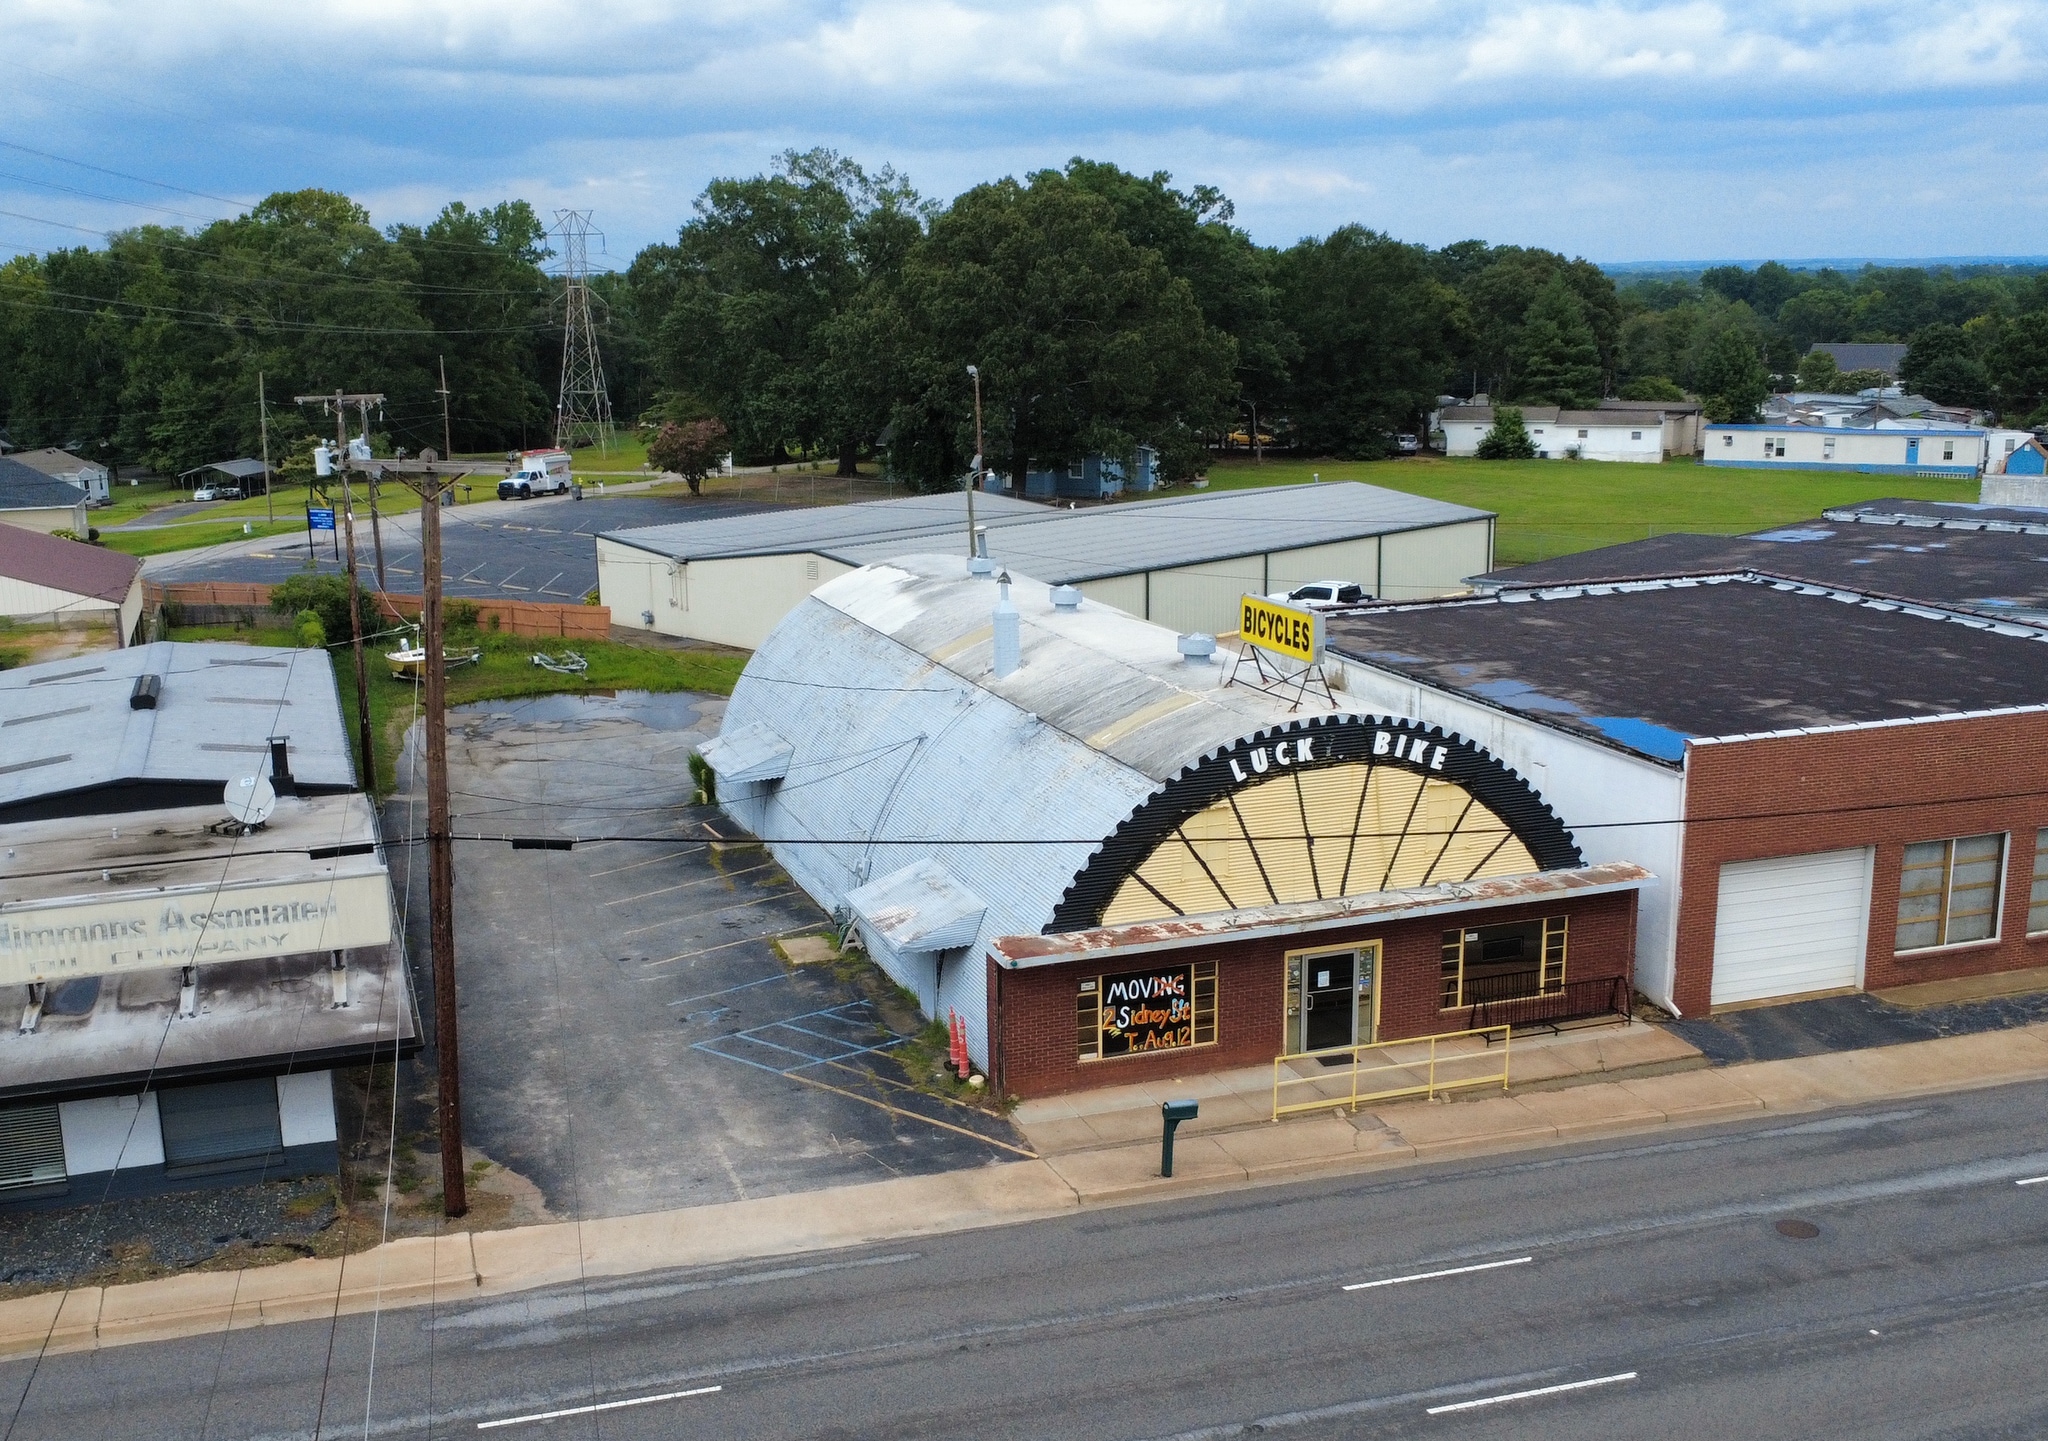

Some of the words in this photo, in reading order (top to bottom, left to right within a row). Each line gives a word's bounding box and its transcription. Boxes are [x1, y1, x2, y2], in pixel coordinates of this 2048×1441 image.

[1243, 605, 1311, 653] BICYCLES
[1372, 731, 1449, 771] BIKE
[1107, 973, 1185, 1004] MOVING
[1116, 1003, 1171, 1030] Sidney
